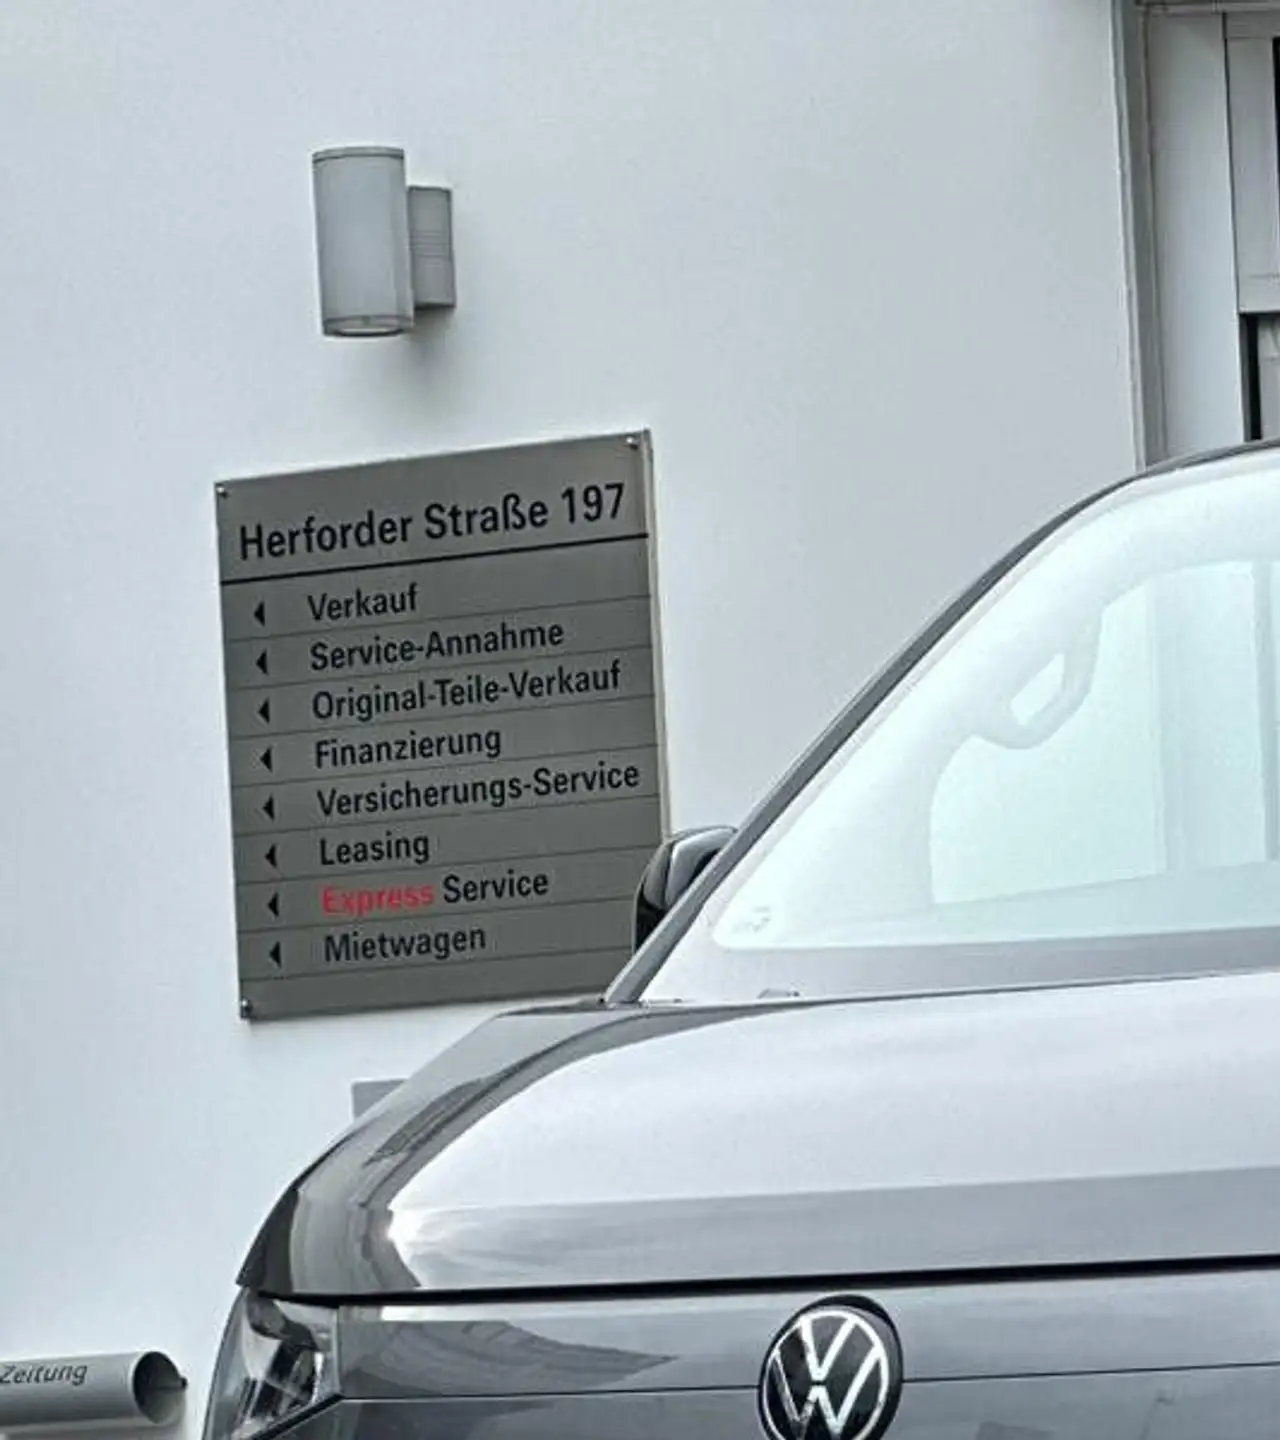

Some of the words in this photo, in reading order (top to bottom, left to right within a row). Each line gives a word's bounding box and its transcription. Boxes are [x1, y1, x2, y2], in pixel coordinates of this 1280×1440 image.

[239, 510, 413, 560] Herforder
[424, 493, 549, 540] Straße
[561, 482, 625, 524] 197
[308, 582, 418, 621] Verkauf
[310, 622, 565, 671] Service-Annahme
[312, 659, 621, 722] Original-Teile-Verkauf
[315, 728, 502, 769] Finanzierung
[317, 760, 640, 817] Versicherungs-Service
[319, 833, 430, 866] Leasing
[322, 884, 435, 916] Express
[443, 869, 549, 904] Service
[324, 926, 487, 963] Mietwagen
[0, 1364, 88, 1387] Zeitung
